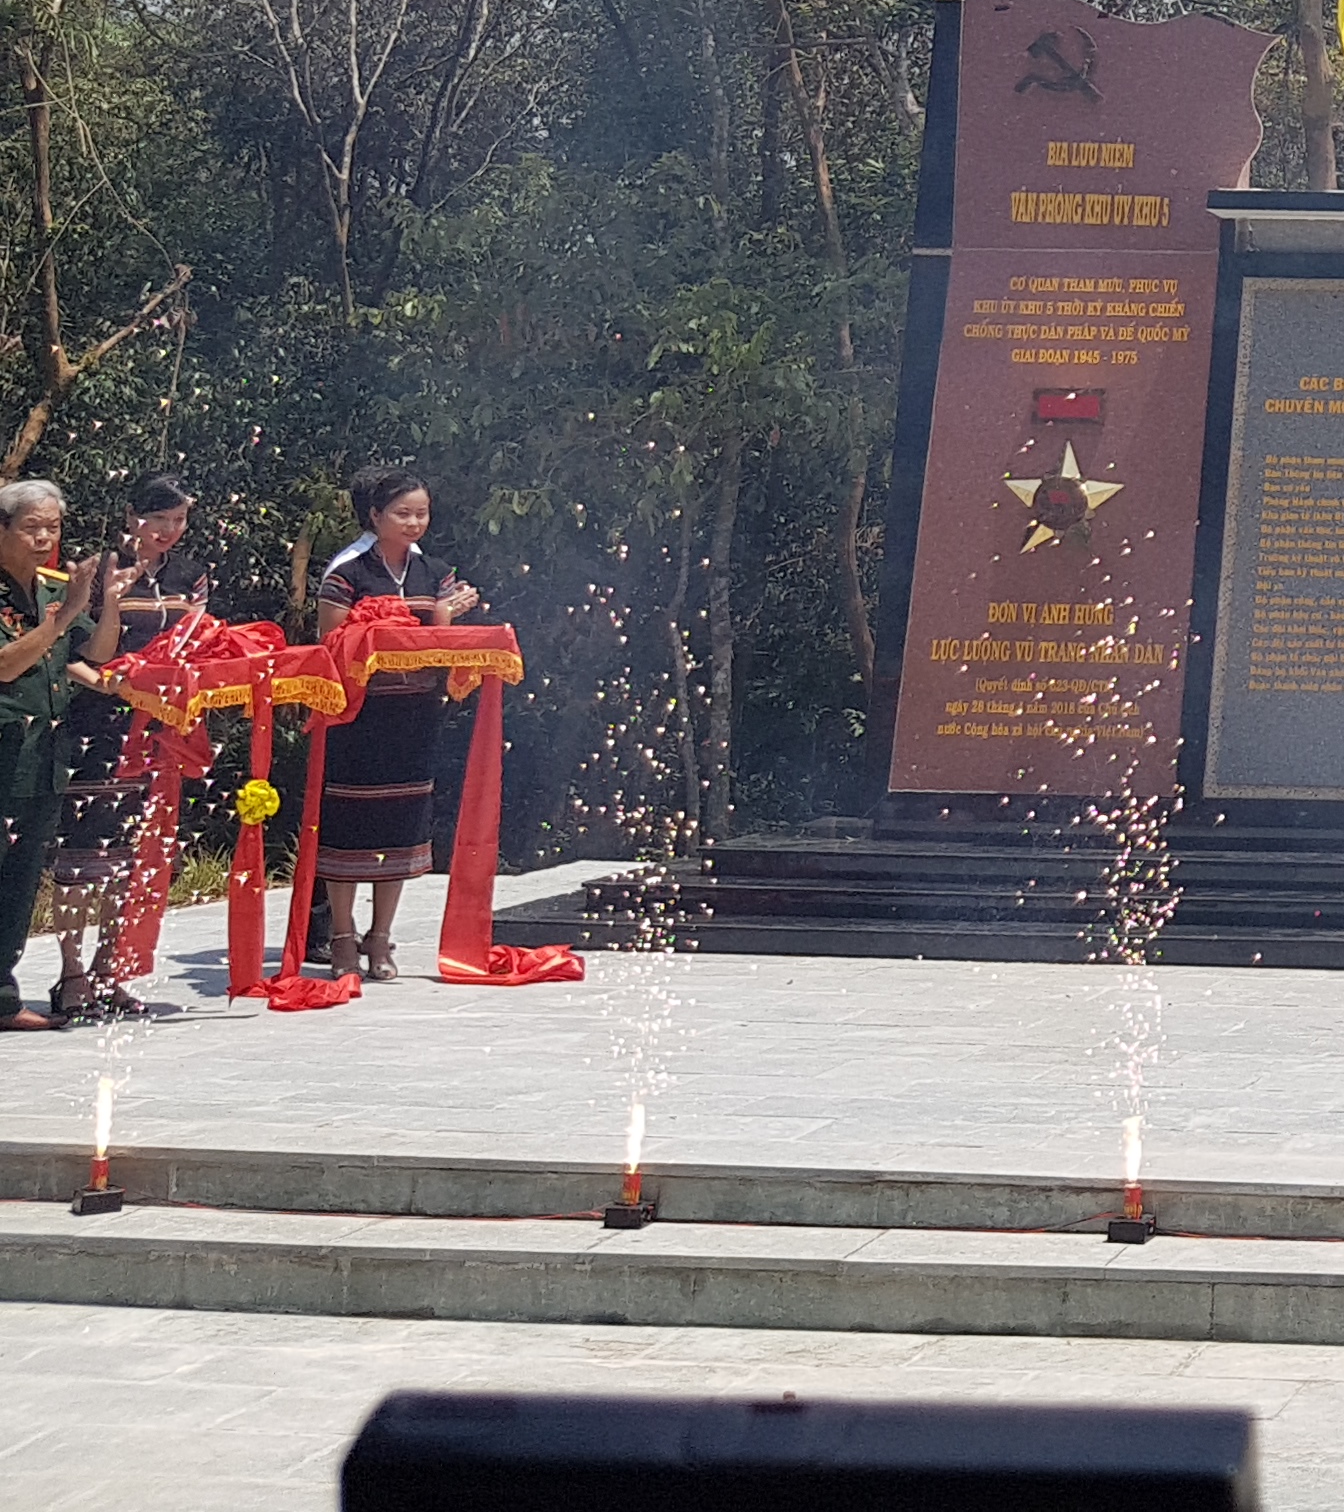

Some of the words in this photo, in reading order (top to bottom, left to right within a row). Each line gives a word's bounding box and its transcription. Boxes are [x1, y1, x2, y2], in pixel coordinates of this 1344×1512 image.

[1047, 141, 1068, 166] BIA
[1072, 140, 1099, 166] LƯU
[1100, 137, 1135, 172] NIỆM
[1011, 185, 1037, 222] VĂN
[1038, 184, 1082, 224] PHÒNG
[1084, 193, 1112, 224] KHU
[1113, 184, 1132, 225] ỦY
[1133, 195, 1161, 227] KHU
[1162, 197, 1170, 227] 5
[1010, 275, 1027, 290] CƠ
[1029, 277, 1059, 293] QUAN
[1063, 277, 1095, 292] THAM
[1129, 279, 1159, 294] PHỤC
[1162, 279, 1178, 295] VỤ
[974, 300, 998, 313] KHU
[1019, 301, 1044, 315] KHU
[1046, 301, 1054, 315] 5
[1057, 298, 1084, 315] THỜI
[1106, 299, 1146, 316] KHÁNG
[1149, 297, 1185, 317] CHIẾN
[964, 318, 1003, 338] CHỐNG
[1006, 324, 1038, 341] THỰC
[1041, 322, 1064, 339] DÂN
[1067, 322, 1098, 340] PHÁP
[1101, 323, 1116, 340] VÀ
[1118, 321, 1136, 341] ĐẾ
[1138, 322, 1170, 343] QUỐC
[1012, 348, 1036, 363] GIAI
[1038, 349, 1070, 365] ĐOẠN
[1073, 349, 1100, 364] 1945
[1111, 350, 1138, 364] 1975
[1300, 374, 1329, 391] CÁC
[1265, 396, 1324, 413] CHUYÊN
[988, 599, 1018, 623] ĐƠN
[1022, 603, 1037, 627] VỊ
[1040, 602, 1071, 624] ANH
[930, 637, 960, 664] LỰC
[1015, 637, 1034, 661] VŨ
[1039, 640, 1086, 663] TRANG
[1134, 636, 1165, 664] DÂN
